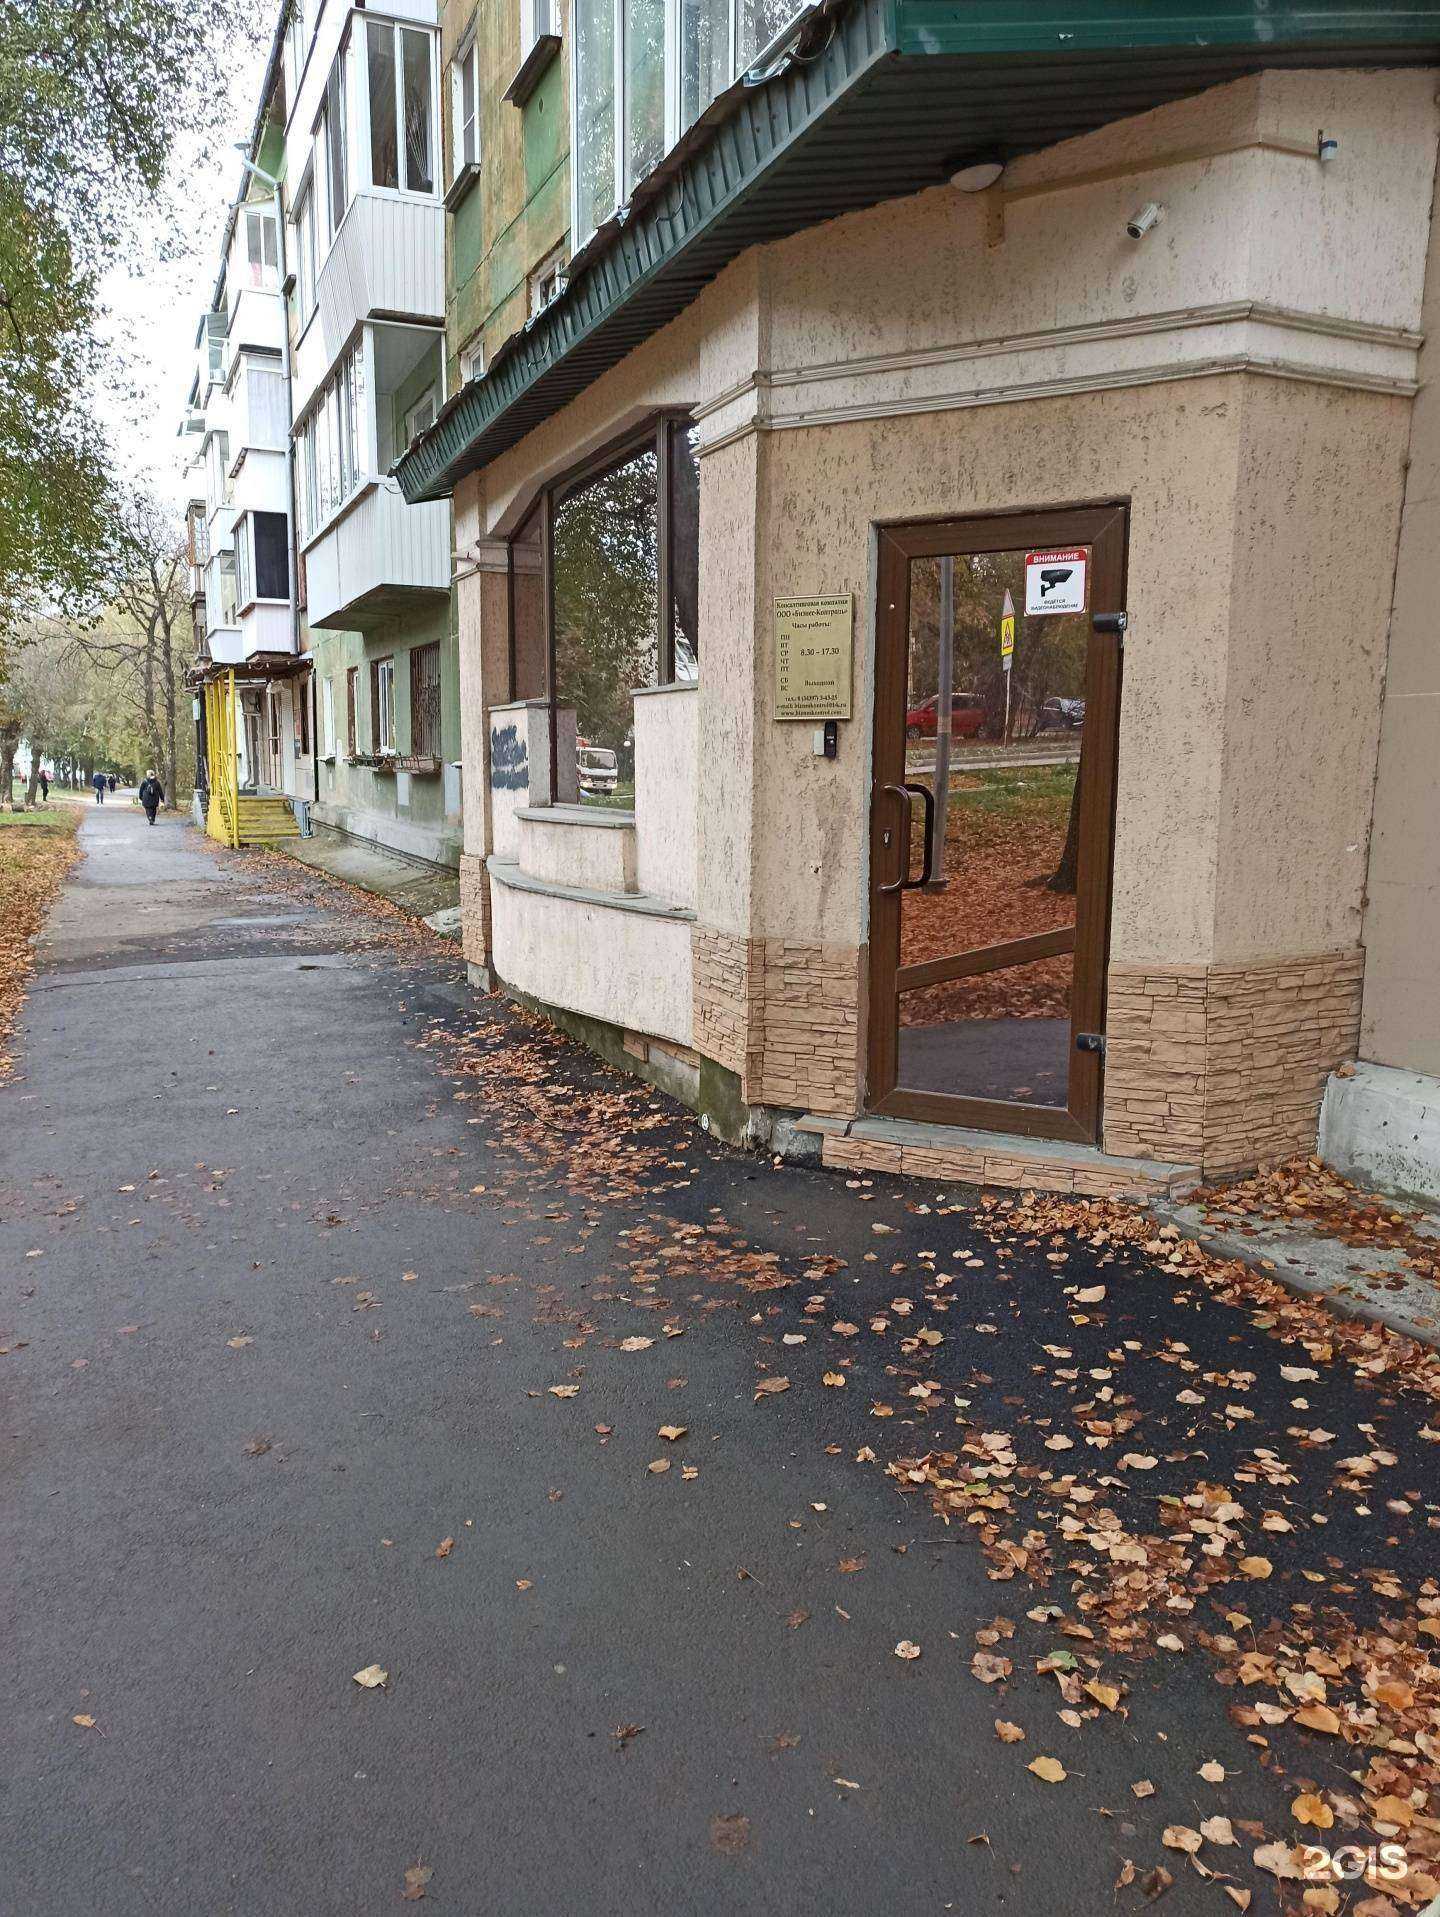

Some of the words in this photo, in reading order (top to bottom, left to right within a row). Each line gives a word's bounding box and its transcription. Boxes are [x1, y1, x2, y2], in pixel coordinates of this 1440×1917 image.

[1033, 552, 1079, 563] ВНИМАНИЕ
[776, 610, 791, 618] ООО
[808, 621, 831, 629] работы:
[821, 647, 840, 655] 17.30
